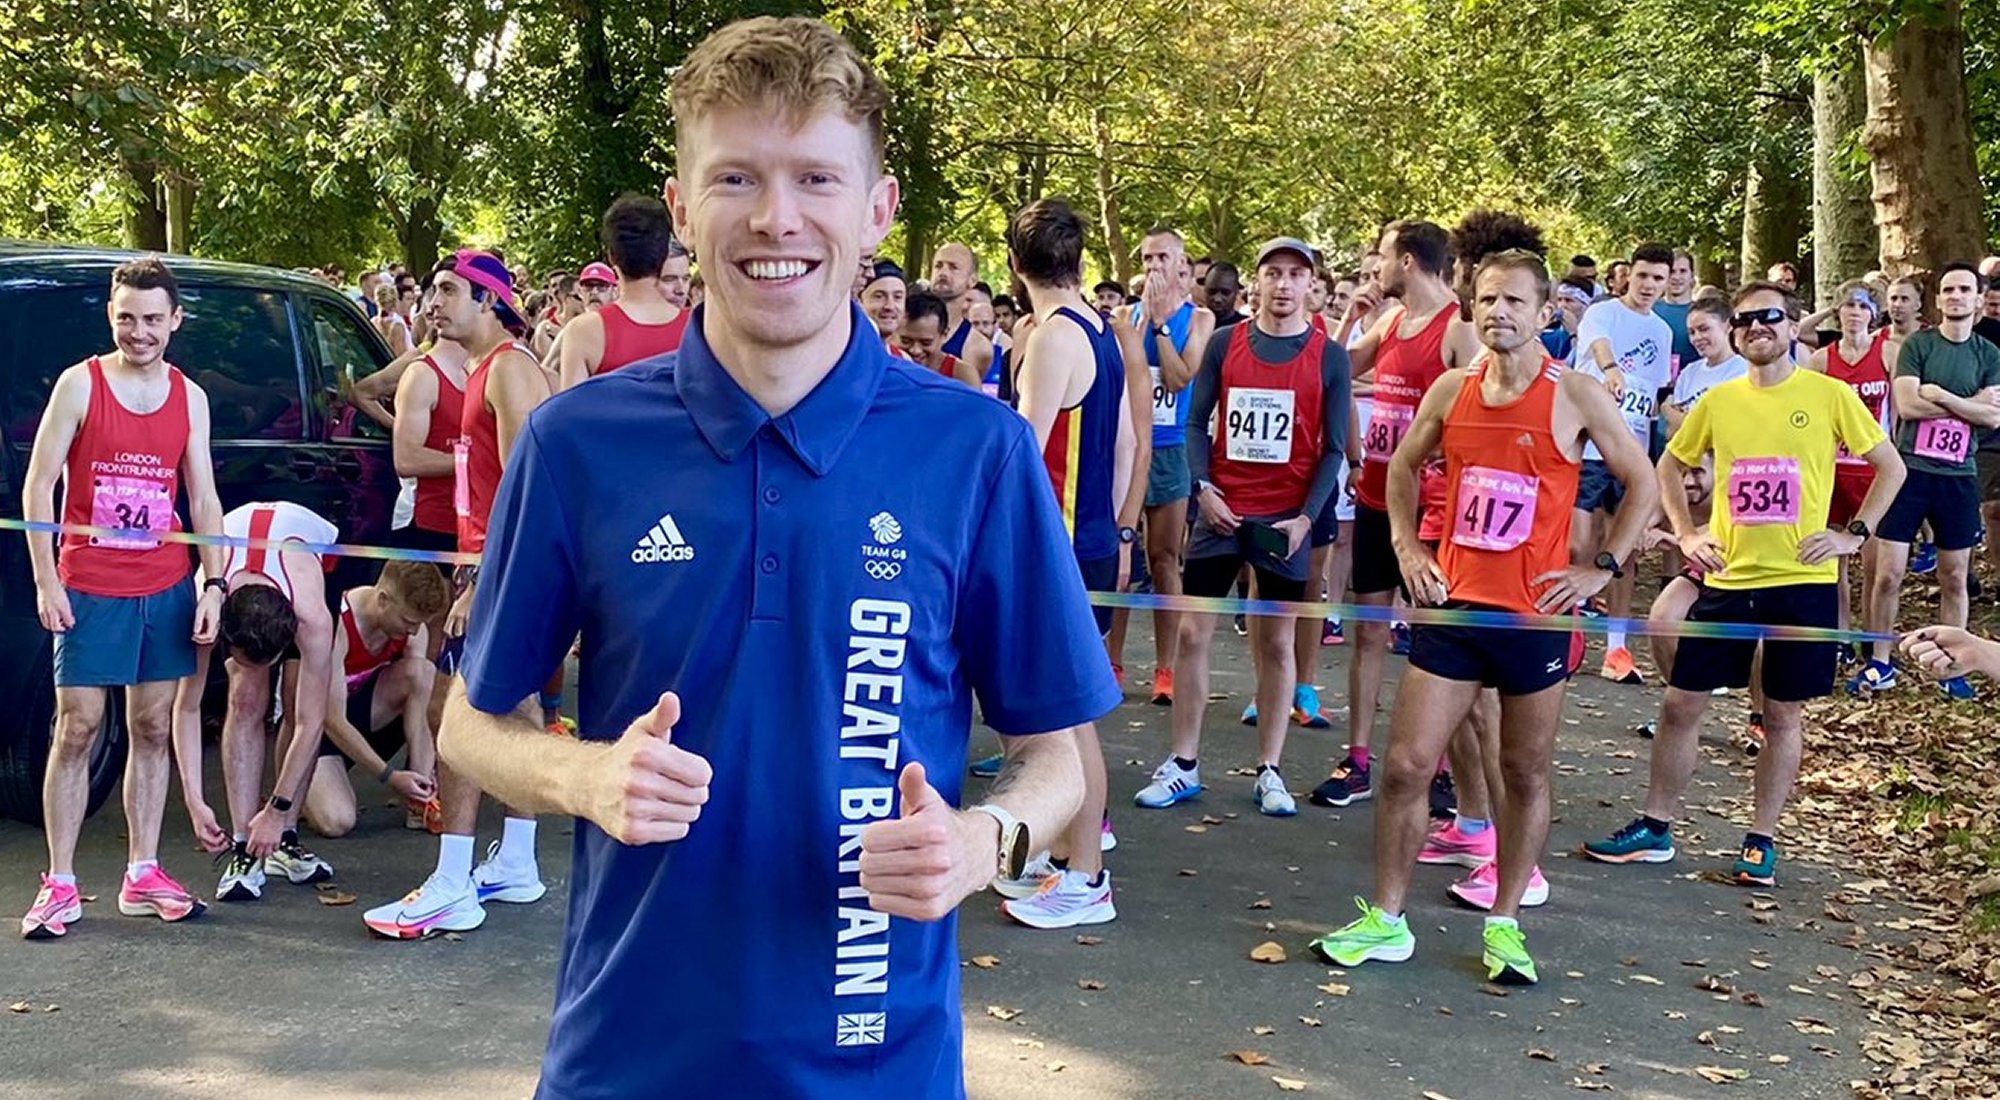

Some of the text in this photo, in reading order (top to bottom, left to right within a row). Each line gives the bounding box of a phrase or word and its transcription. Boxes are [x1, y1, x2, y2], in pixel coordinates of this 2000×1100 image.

[1152, 385, 1176, 409] 90
[1861, 380, 1885, 396] OUT
[1229, 410, 1290, 441] 9412
[1926, 426, 1963, 453] 138
[114, 452, 161, 465] LONDON
[1737, 480, 1790, 513] 534
[112, 503, 150, 531] 34
[1463, 495, 1525, 537] 417
[631, 544, 695, 563] adidas
[861, 545, 907, 560] TEAM GB
[840, 598, 911, 770] GREAT
